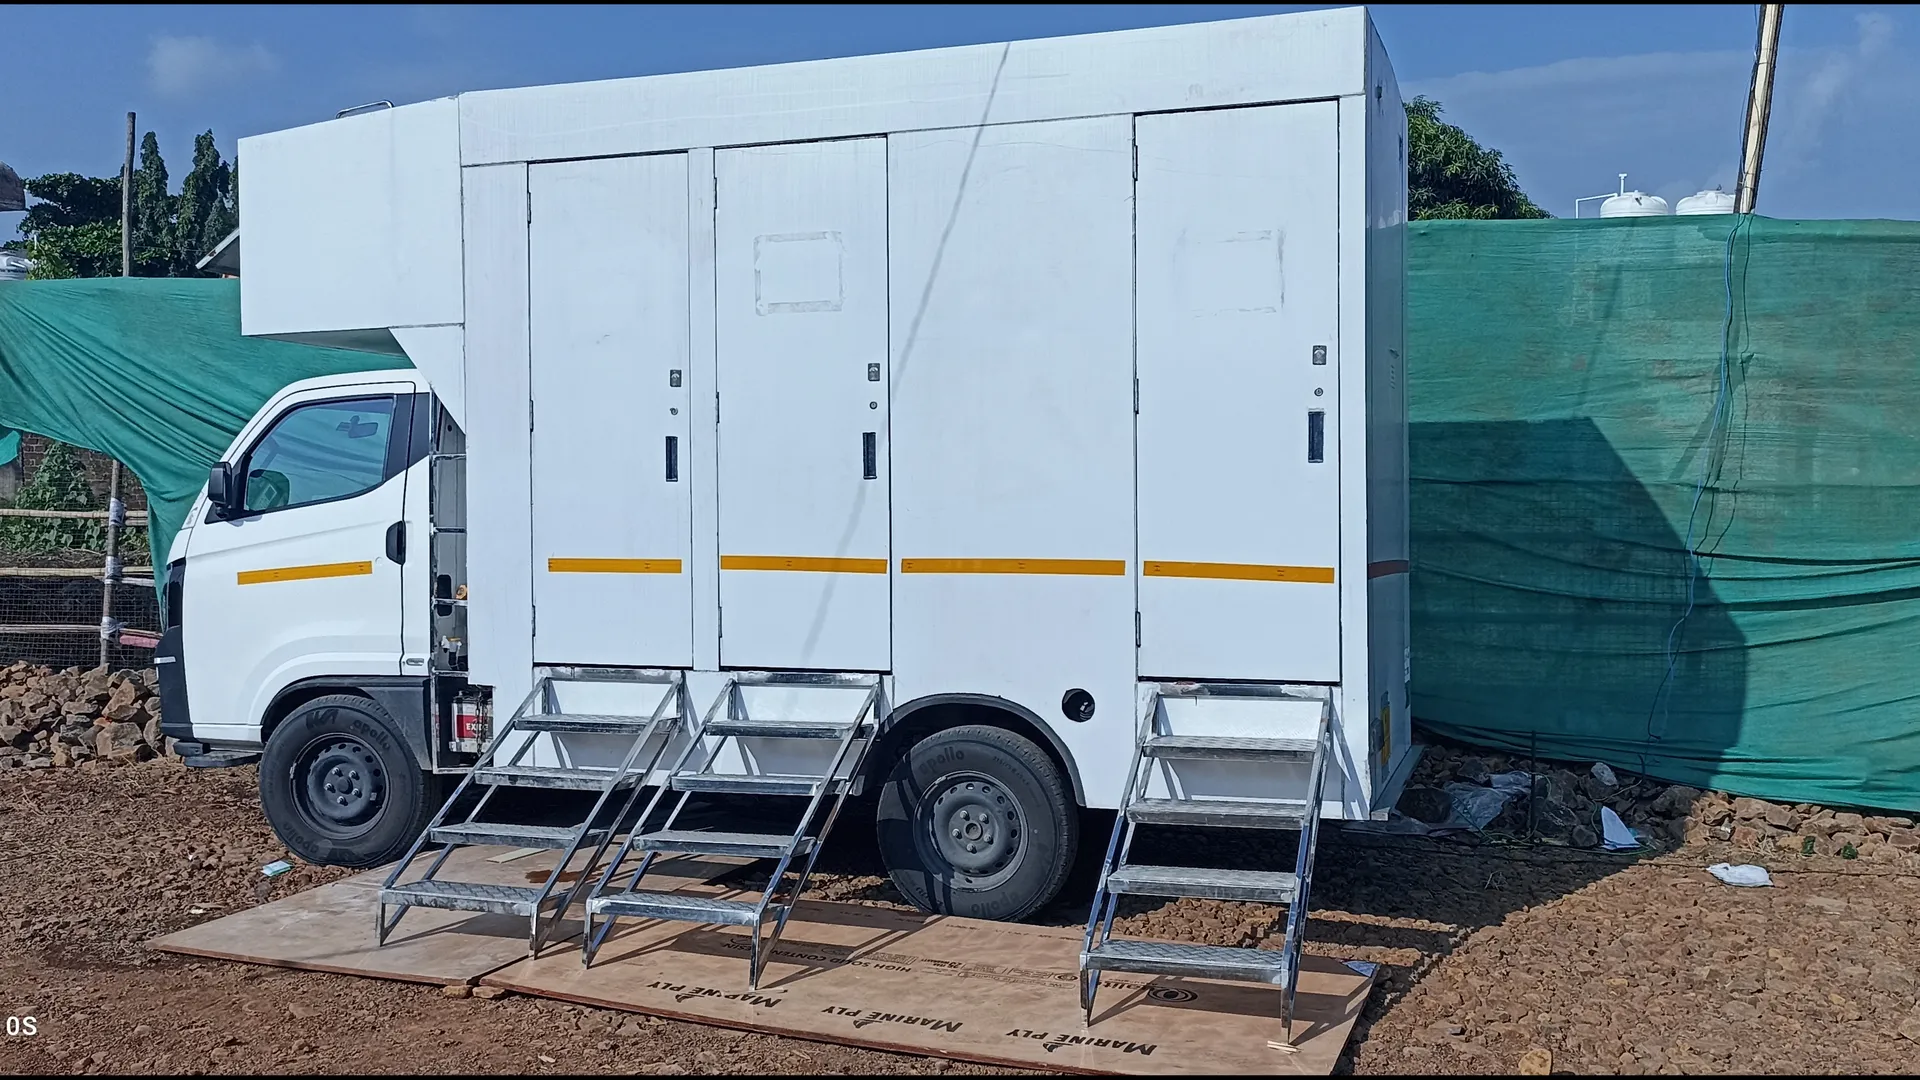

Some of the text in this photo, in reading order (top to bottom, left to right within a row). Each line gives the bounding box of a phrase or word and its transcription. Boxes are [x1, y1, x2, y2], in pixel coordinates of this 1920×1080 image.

[352, 719, 391, 751] apollo
[918, 746, 965, 775] apollo
[873, 963, 912, 972] HIGH
[646, 981, 687, 993] PLY
[821, 1005, 963, 1032] MARINE PLY
[1006, 1028, 1157, 1056] MARINE PLY
